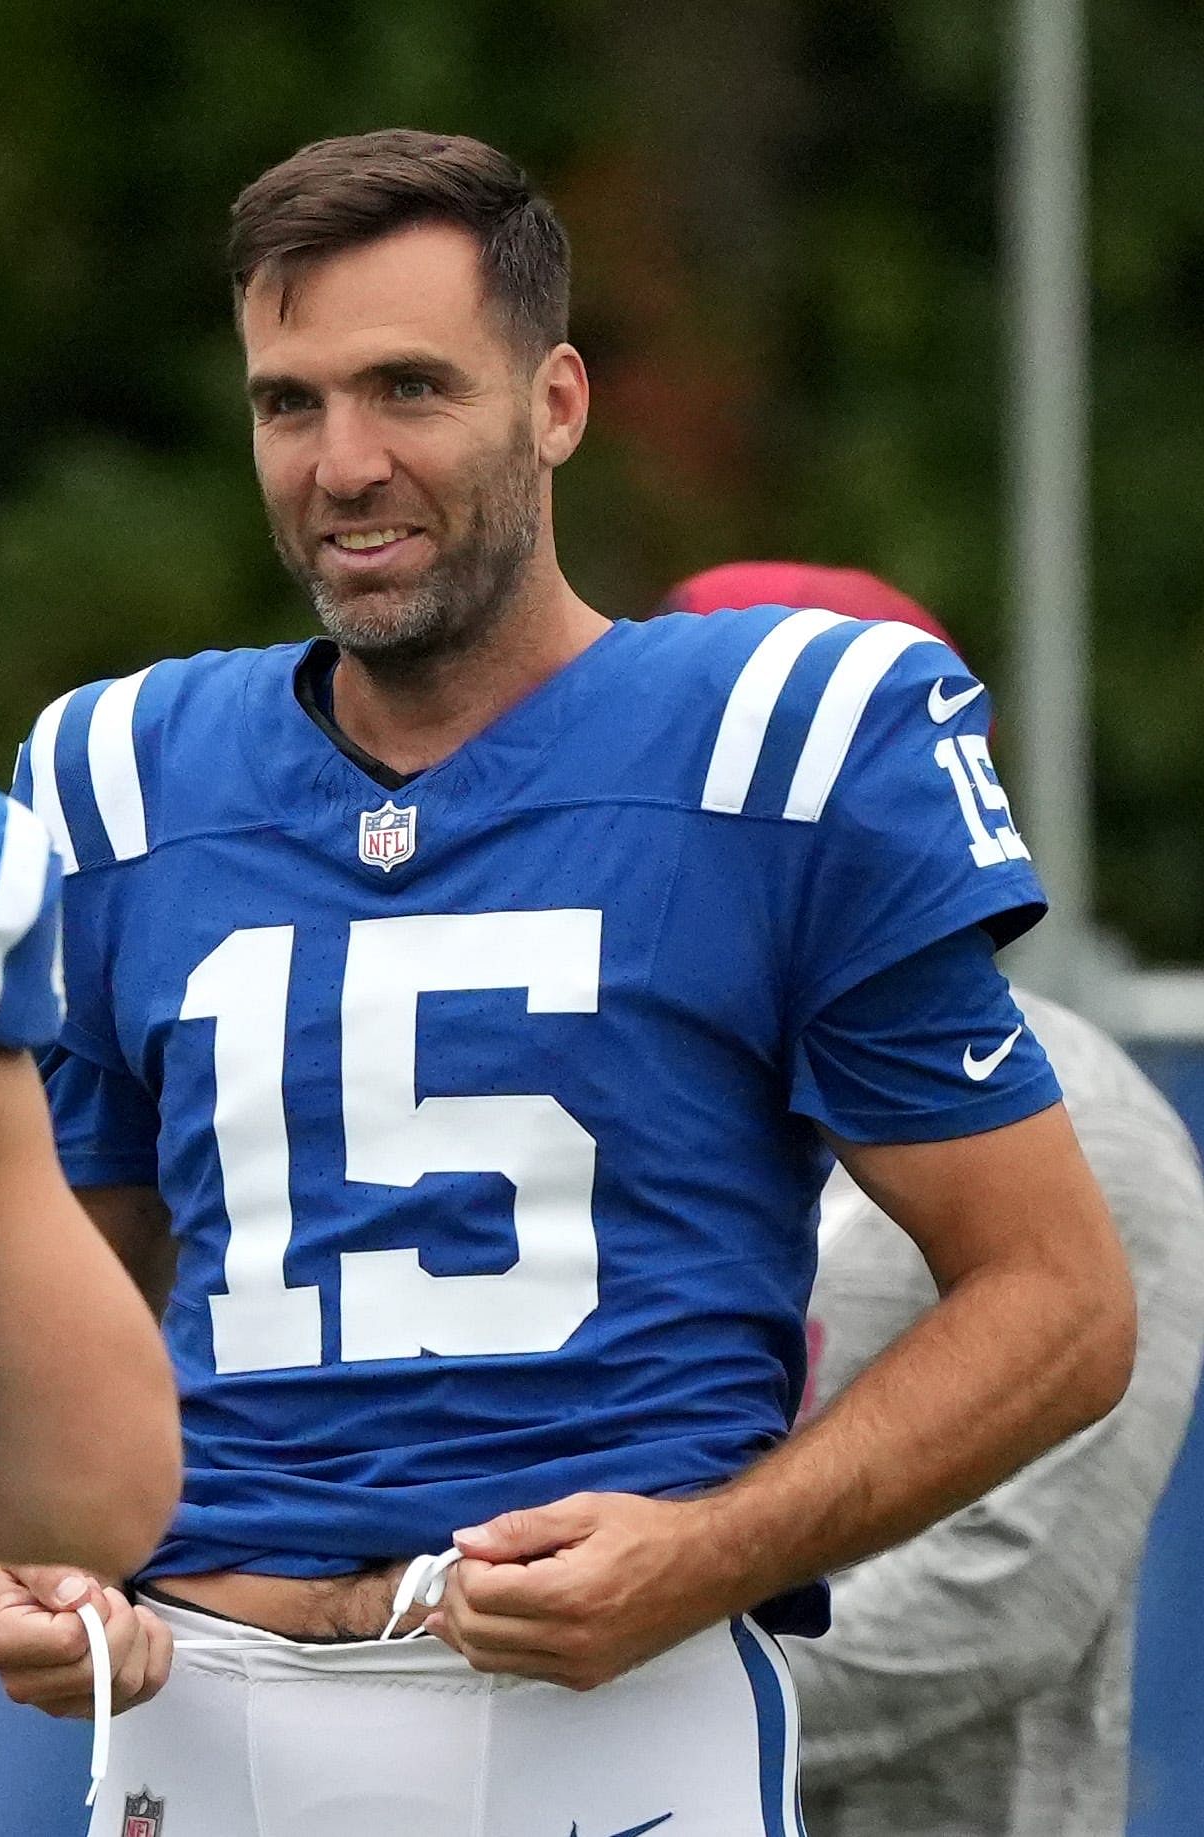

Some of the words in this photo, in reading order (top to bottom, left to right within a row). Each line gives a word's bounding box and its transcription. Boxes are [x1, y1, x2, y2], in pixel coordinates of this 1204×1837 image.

[368, 831, 404, 857] NFL
[933, 733, 1032, 868] 15
[179, 908, 603, 1375] 15
